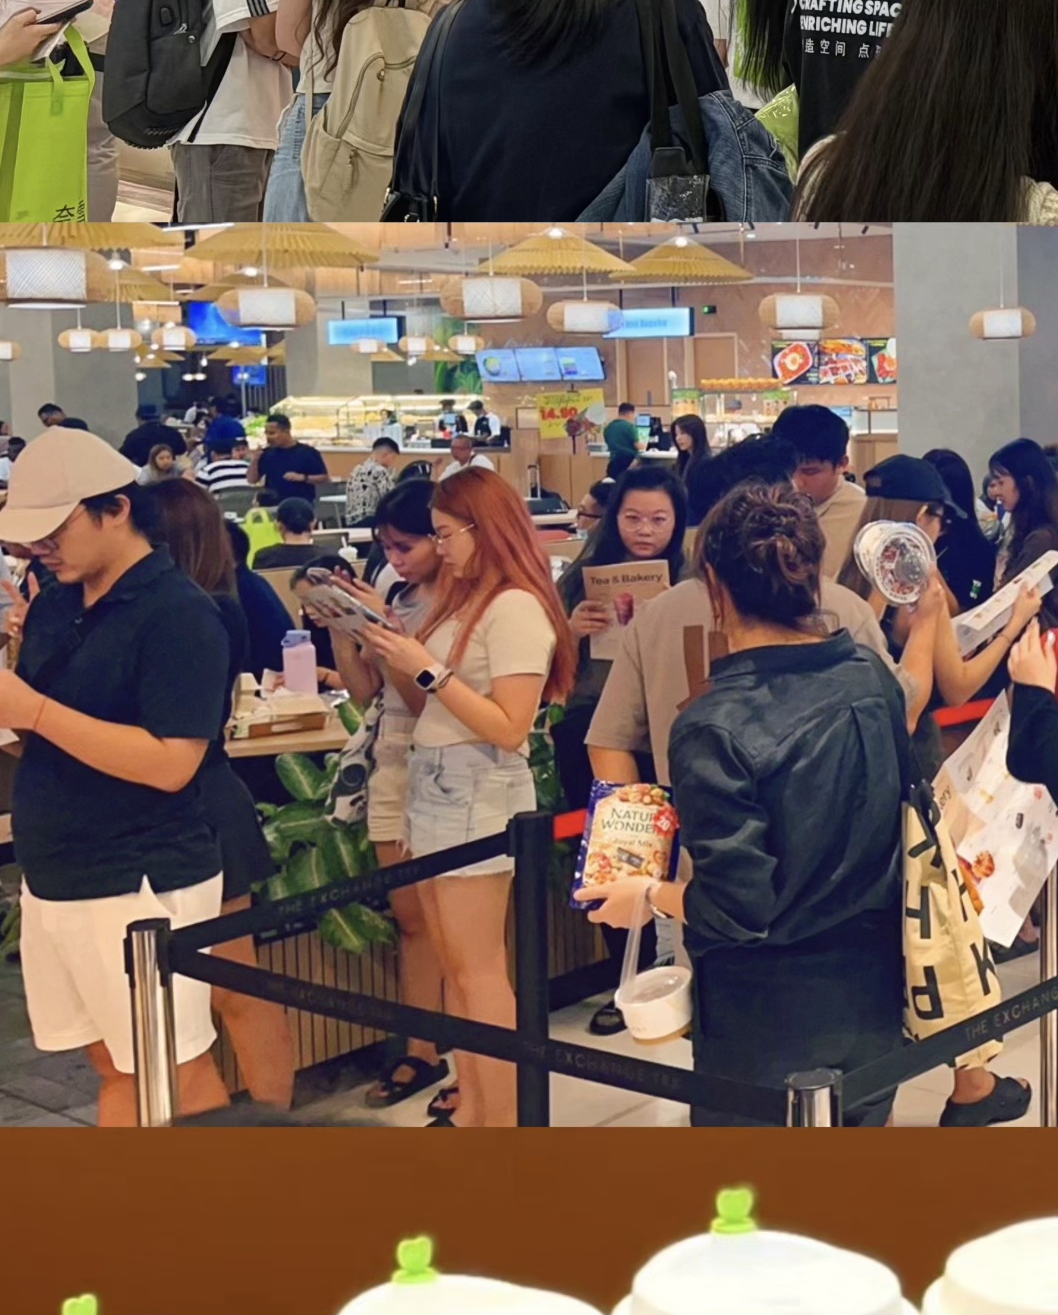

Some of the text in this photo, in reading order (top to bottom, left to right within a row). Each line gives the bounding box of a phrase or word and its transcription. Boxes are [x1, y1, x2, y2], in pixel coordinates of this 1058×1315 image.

[864, 0, 902, 18] SPAC
[802, 38, 882, 58] 造空间 点
[622, 574, 663, 582] Bakery
[965, 1019, 988, 1042] THE
